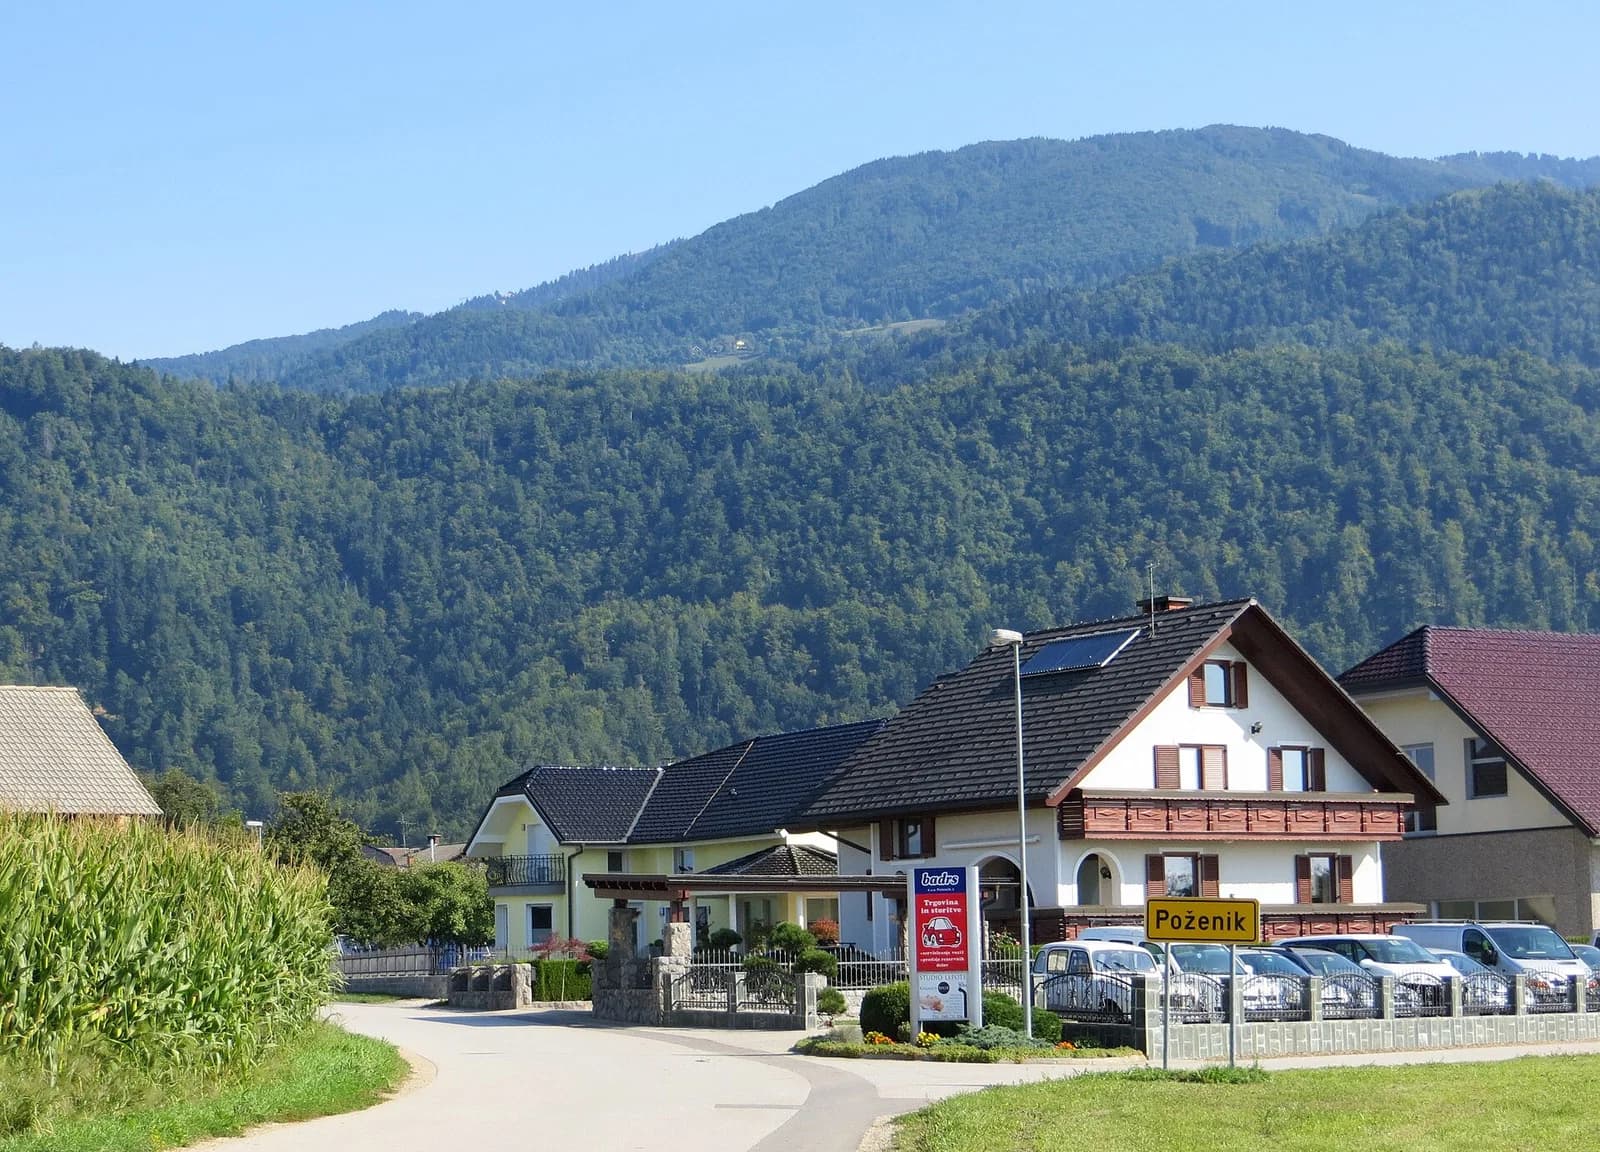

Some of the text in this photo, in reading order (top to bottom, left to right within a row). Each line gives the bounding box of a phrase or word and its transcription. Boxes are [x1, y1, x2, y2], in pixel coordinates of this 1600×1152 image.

[921, 871, 960, 887] badrs
[923, 899, 959, 907] Trgovina
[931, 906, 962, 914] storitve
[1155, 909, 1247, 932] Poženik
